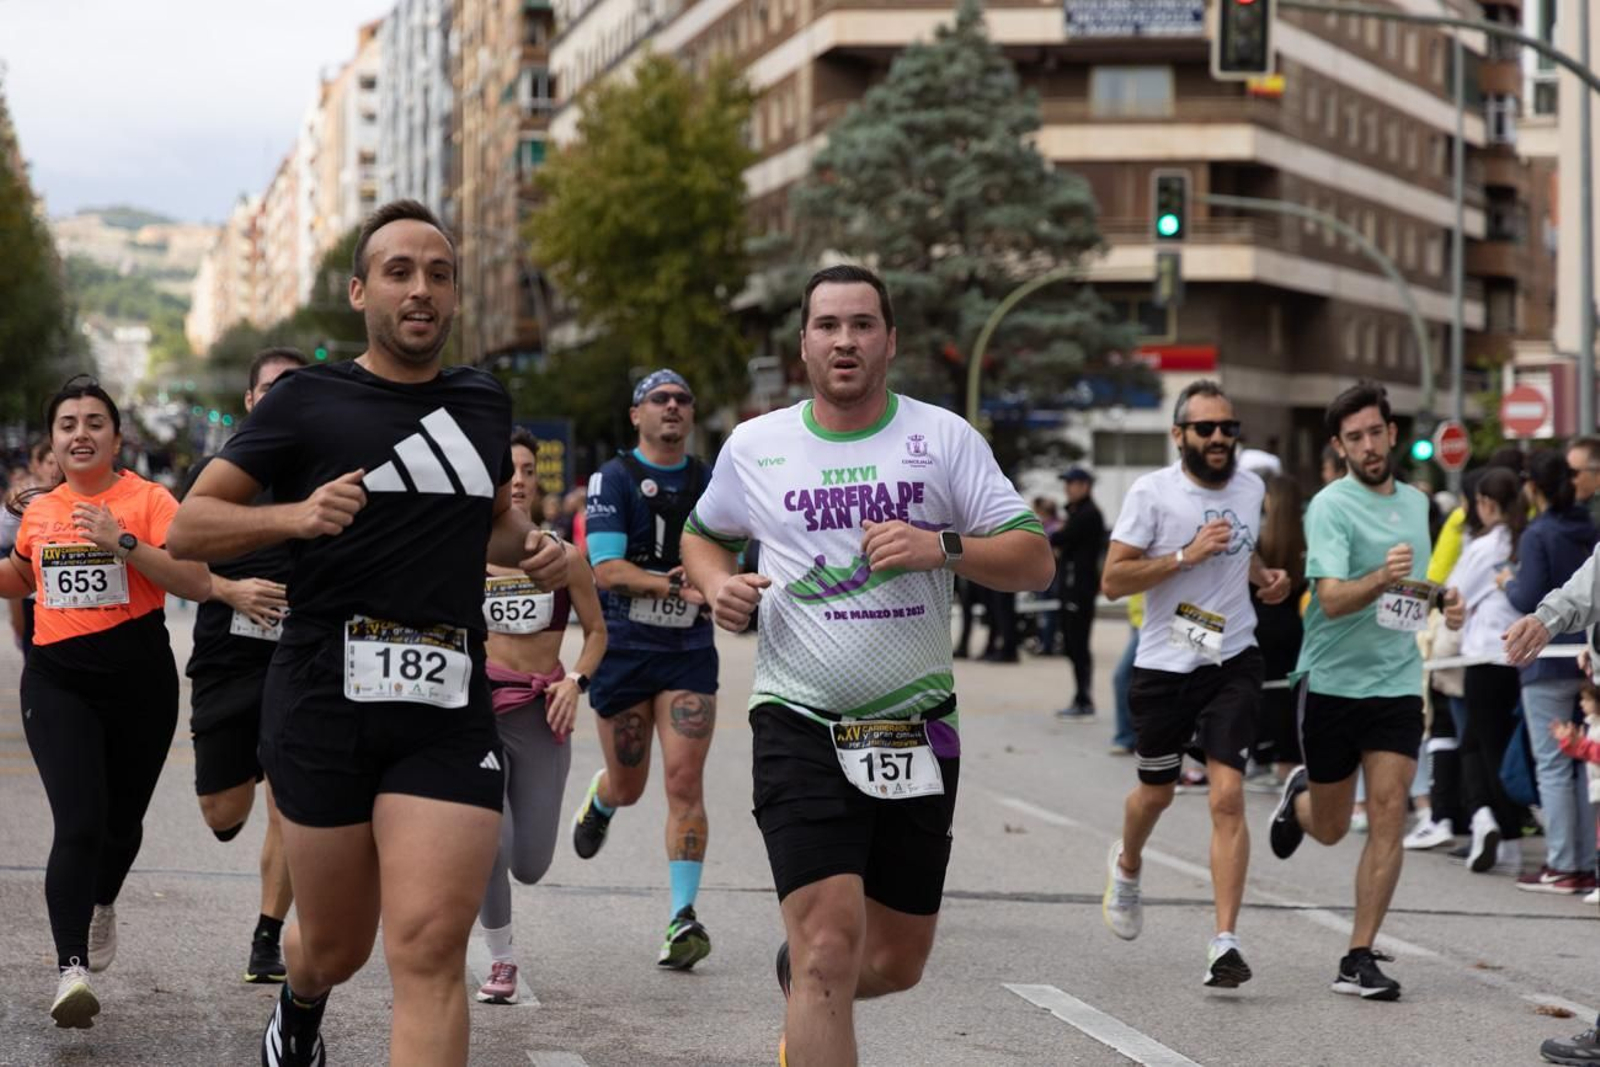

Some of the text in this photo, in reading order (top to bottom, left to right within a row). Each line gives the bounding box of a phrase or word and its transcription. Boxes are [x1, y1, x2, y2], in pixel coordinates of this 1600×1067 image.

[758, 457, 786, 467] vive
[821, 465, 877, 486] XXXVI
[784, 481, 925, 512] CARRERA DE
[804, 508, 853, 532] SAN
[58, 569, 107, 593] 653
[490, 599, 537, 622] 652
[651, 597, 687, 616] 169
[825, 604, 925, 620] 9 DE MARZO DE 2025
[1391, 598, 1421, 620] 473
[375, 647, 447, 685] 182
[859, 752, 913, 782] 157
